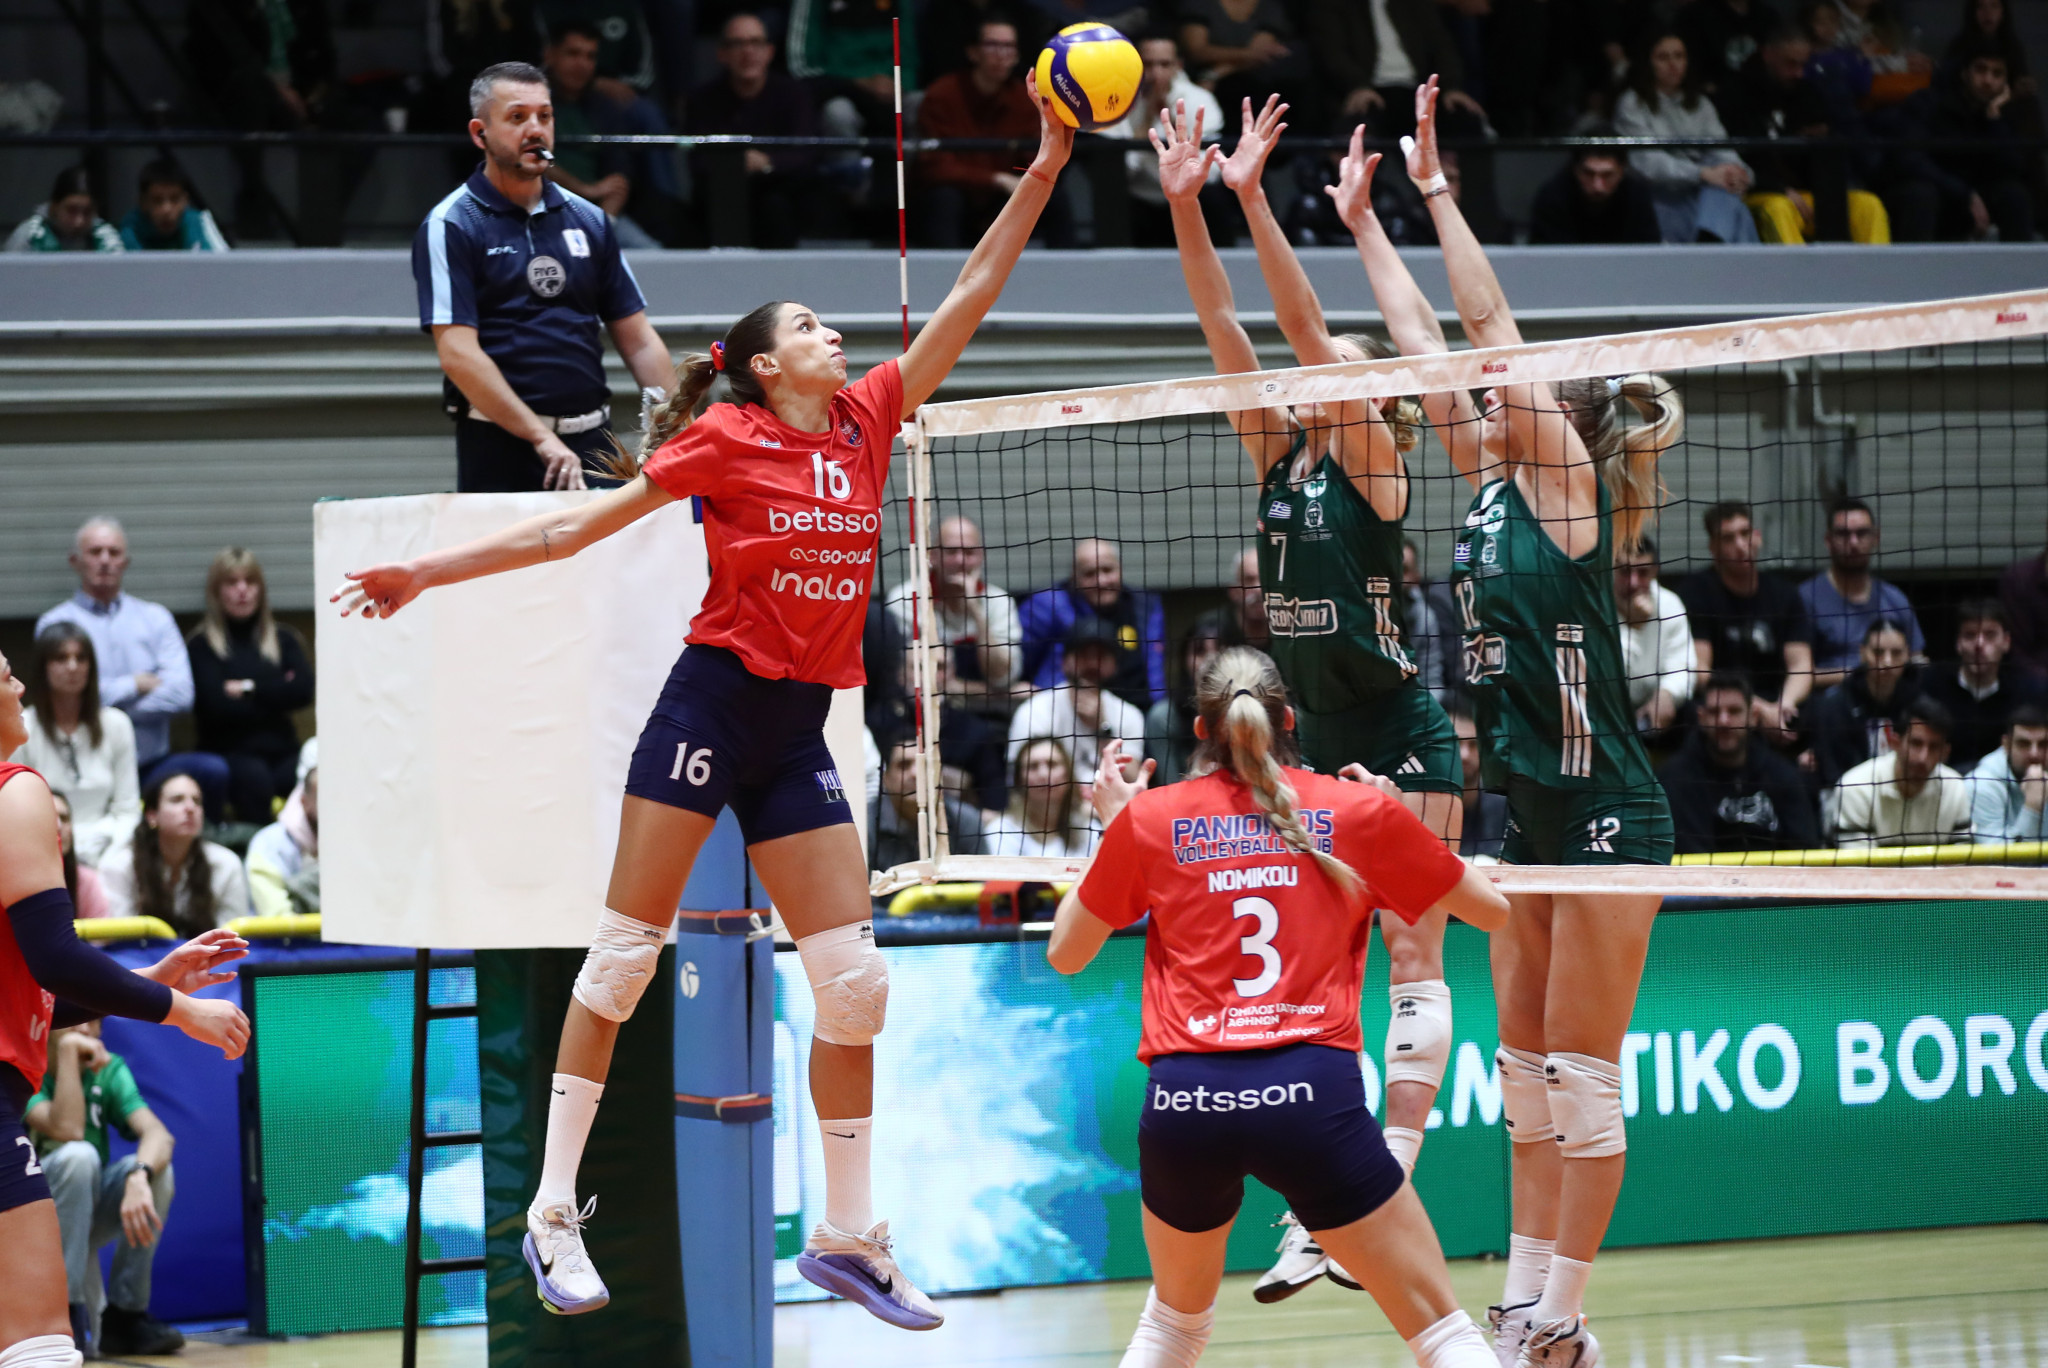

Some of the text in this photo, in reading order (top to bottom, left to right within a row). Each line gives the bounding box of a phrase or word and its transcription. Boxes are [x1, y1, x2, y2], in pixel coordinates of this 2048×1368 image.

[533, 266, 559, 278] FIVB
[811, 451, 851, 500] 16
[768, 506, 882, 534] betsso
[1269, 531, 1288, 582] 7
[1455, 576, 1481, 631] 12
[668, 741, 713, 787] 16
[1172, 808, 1334, 848] PANIONOS
[1587, 816, 1622, 840] 12
[1173, 837, 1287, 866] VOLLEYBALL
[1208, 865, 1298, 893] NOMIKOU
[1232, 895, 1283, 999] 3
[1226, 1014, 1281, 1028] ΑΘΗΝΩΝ
[1228, 1004, 1275, 1018] ΟΜΙΛΟΣ
[1152, 1081, 1315, 1113] betsson
[14, 1135, 43, 1177] 2
